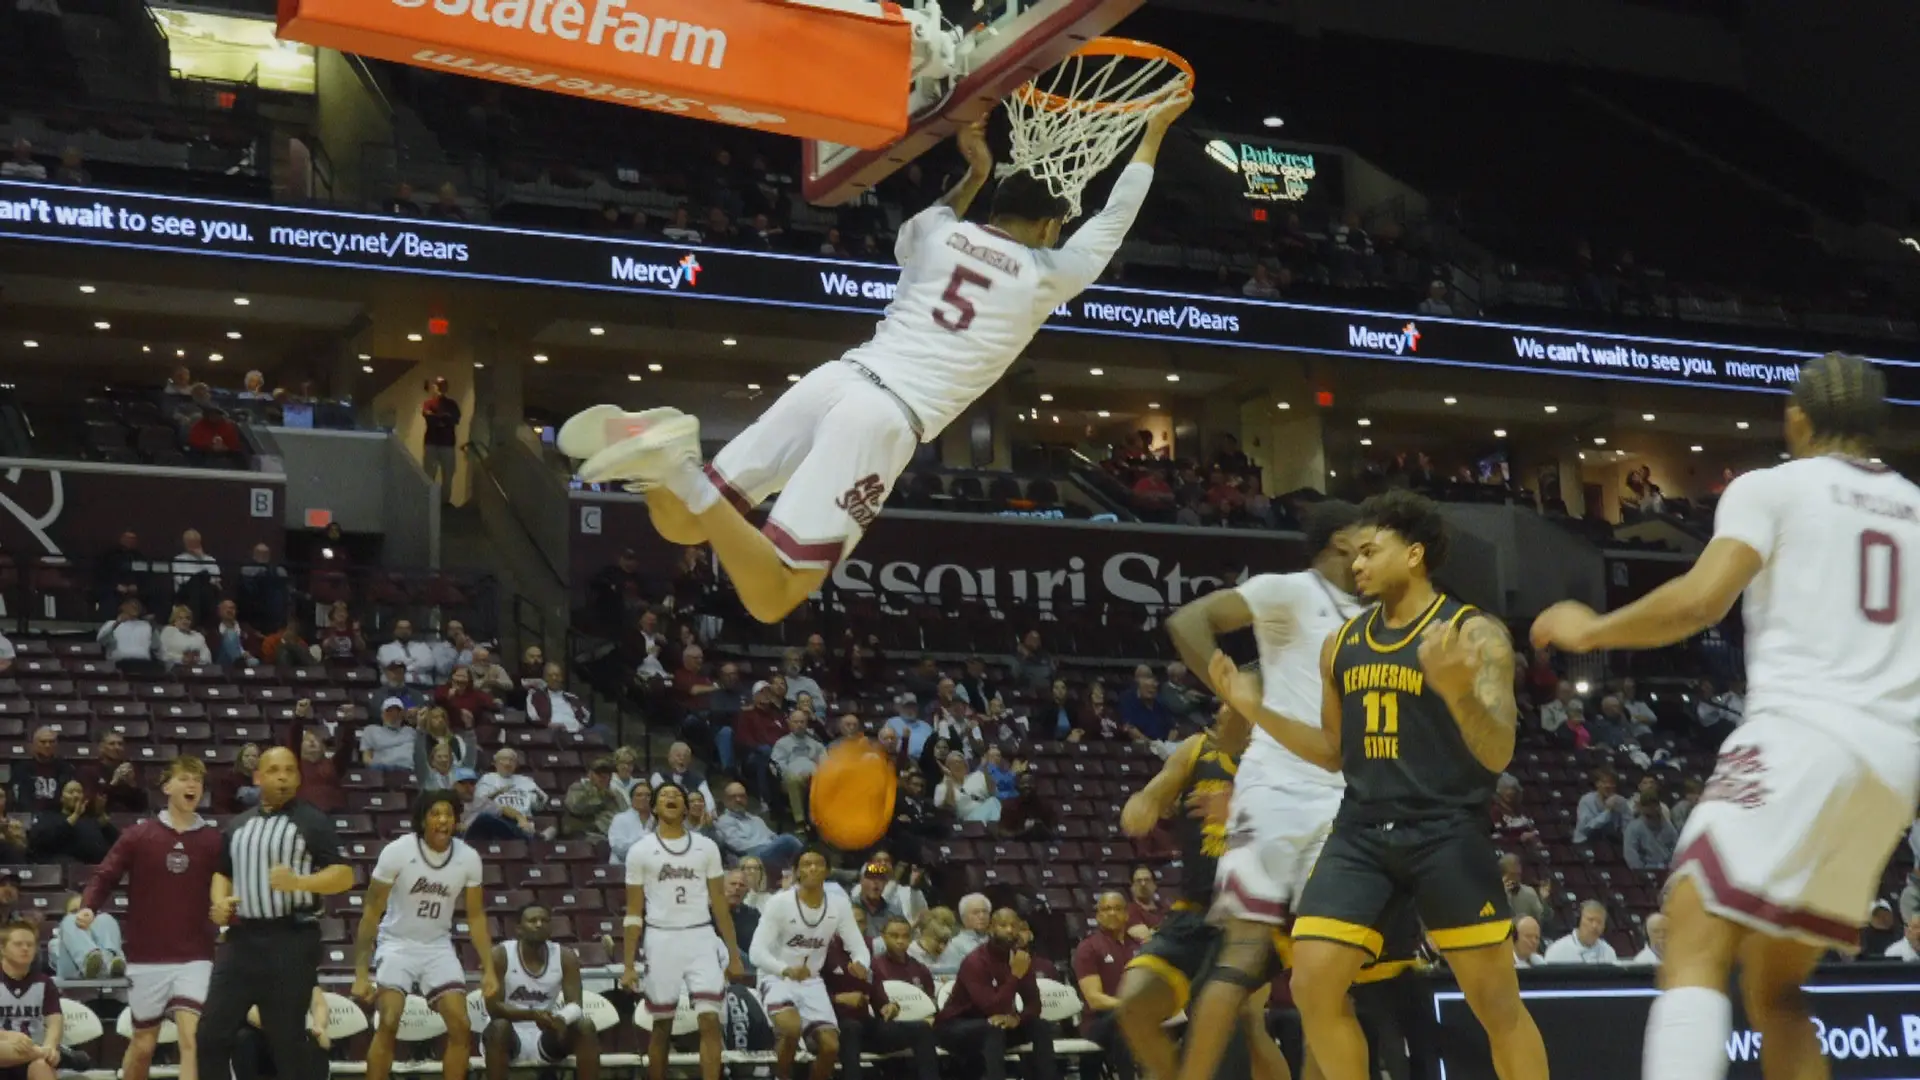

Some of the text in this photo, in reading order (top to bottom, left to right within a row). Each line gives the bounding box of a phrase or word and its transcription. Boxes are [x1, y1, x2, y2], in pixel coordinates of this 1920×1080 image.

[432, 0, 584, 41] ate
[1240, 143, 1314, 170] Parkcrest
[0, 197, 470, 263] an't wait to see you. mercy.net/Bears
[611, 255, 683, 290] Mercy
[820, 271, 859, 298] We
[861, 280, 897, 300] can
[1083, 301, 1240, 333] mercy.net/Bears
[930, 263, 993, 333] 5
[1349, 323, 1406, 355] Mercy
[1513, 336, 1546, 359] We
[1548, 341, 1591, 364] can't
[1590, 345, 1630, 367] wait
[1631, 348, 1649, 370] to
[1651, 354, 1681, 372] see
[1681, 356, 1716, 377] you.
[254, 491, 269, 512] B
[584, 510, 599, 530] C
[831, 556, 1088, 621] ssouri
[1858, 528, 1901, 626] 0
[1343, 663, 1424, 697] KENNESAW
[1363, 690, 1399, 733] 11
[1364, 735, 1399, 760] STATE
[416, 900, 441, 920] 20
[675, 885, 687, 905] 2
[727, 991, 750, 1050] adida
